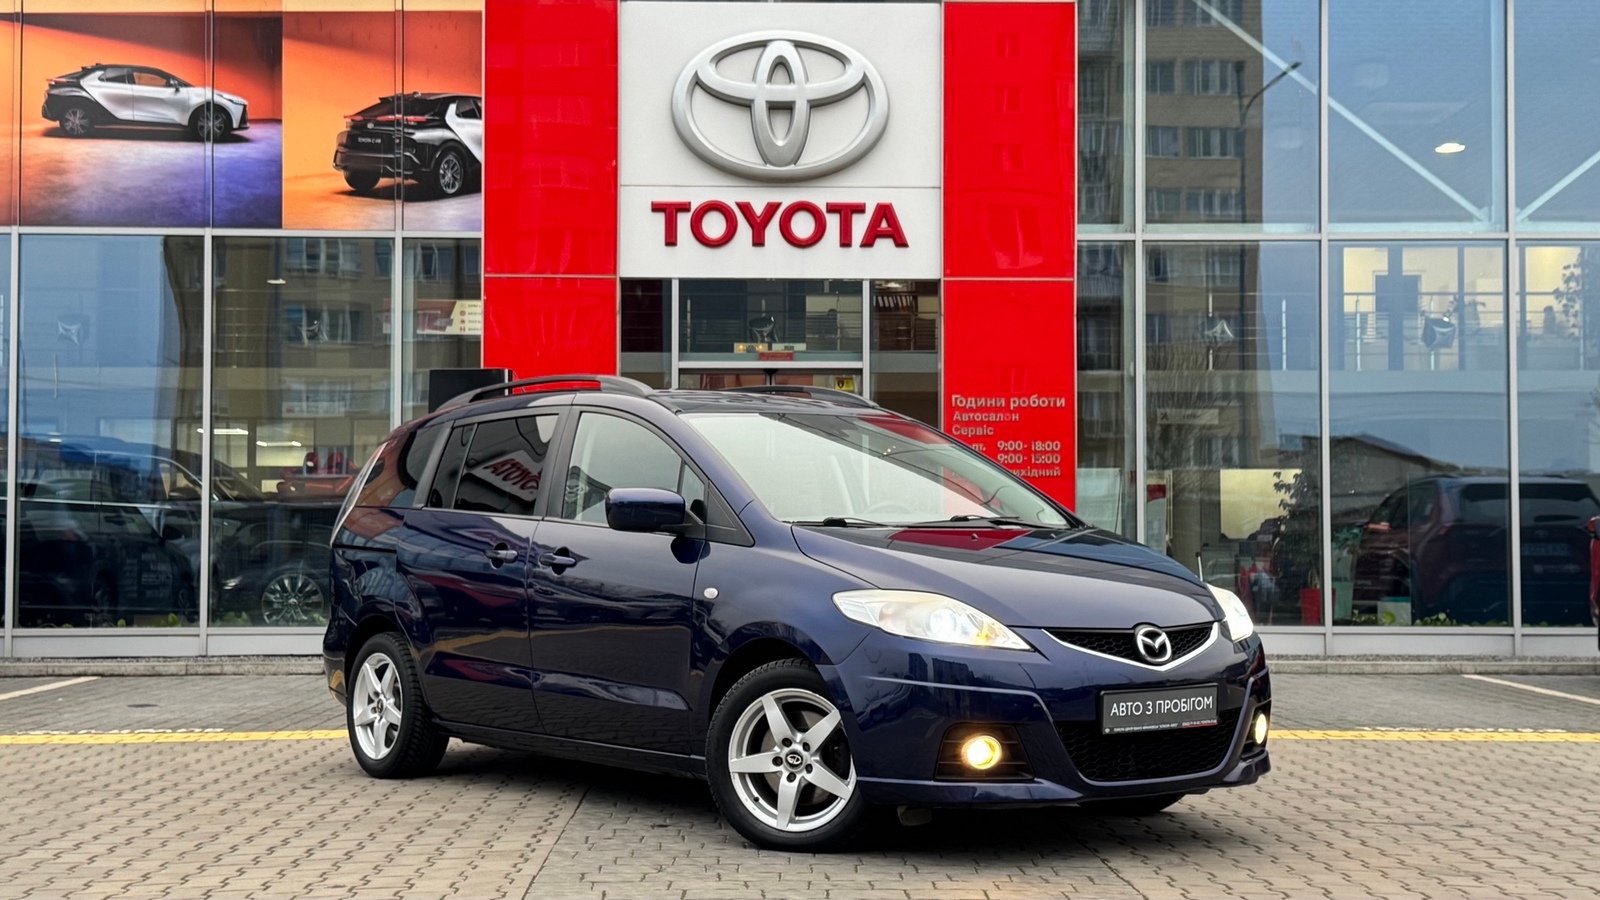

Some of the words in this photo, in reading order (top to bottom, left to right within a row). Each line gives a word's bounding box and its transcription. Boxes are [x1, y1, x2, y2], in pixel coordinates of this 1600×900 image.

[651, 200, 909, 248] TOYOTA
[951, 395, 1006, 409] Години
[1010, 394, 1066, 410] роботи
[952, 411, 1020, 422] Автосалон
[952, 424, 994, 437] Сервіс
[1031, 440, 1061, 451] 18:00
[1031, 453, 1061, 464] 15:00
[1011, 466, 1061, 478] ихідний
[1110, 701, 1143, 717] АВТО
[1145, 700, 1153, 715] З
[1156, 695, 1213, 714] ПРОБІГОМ
